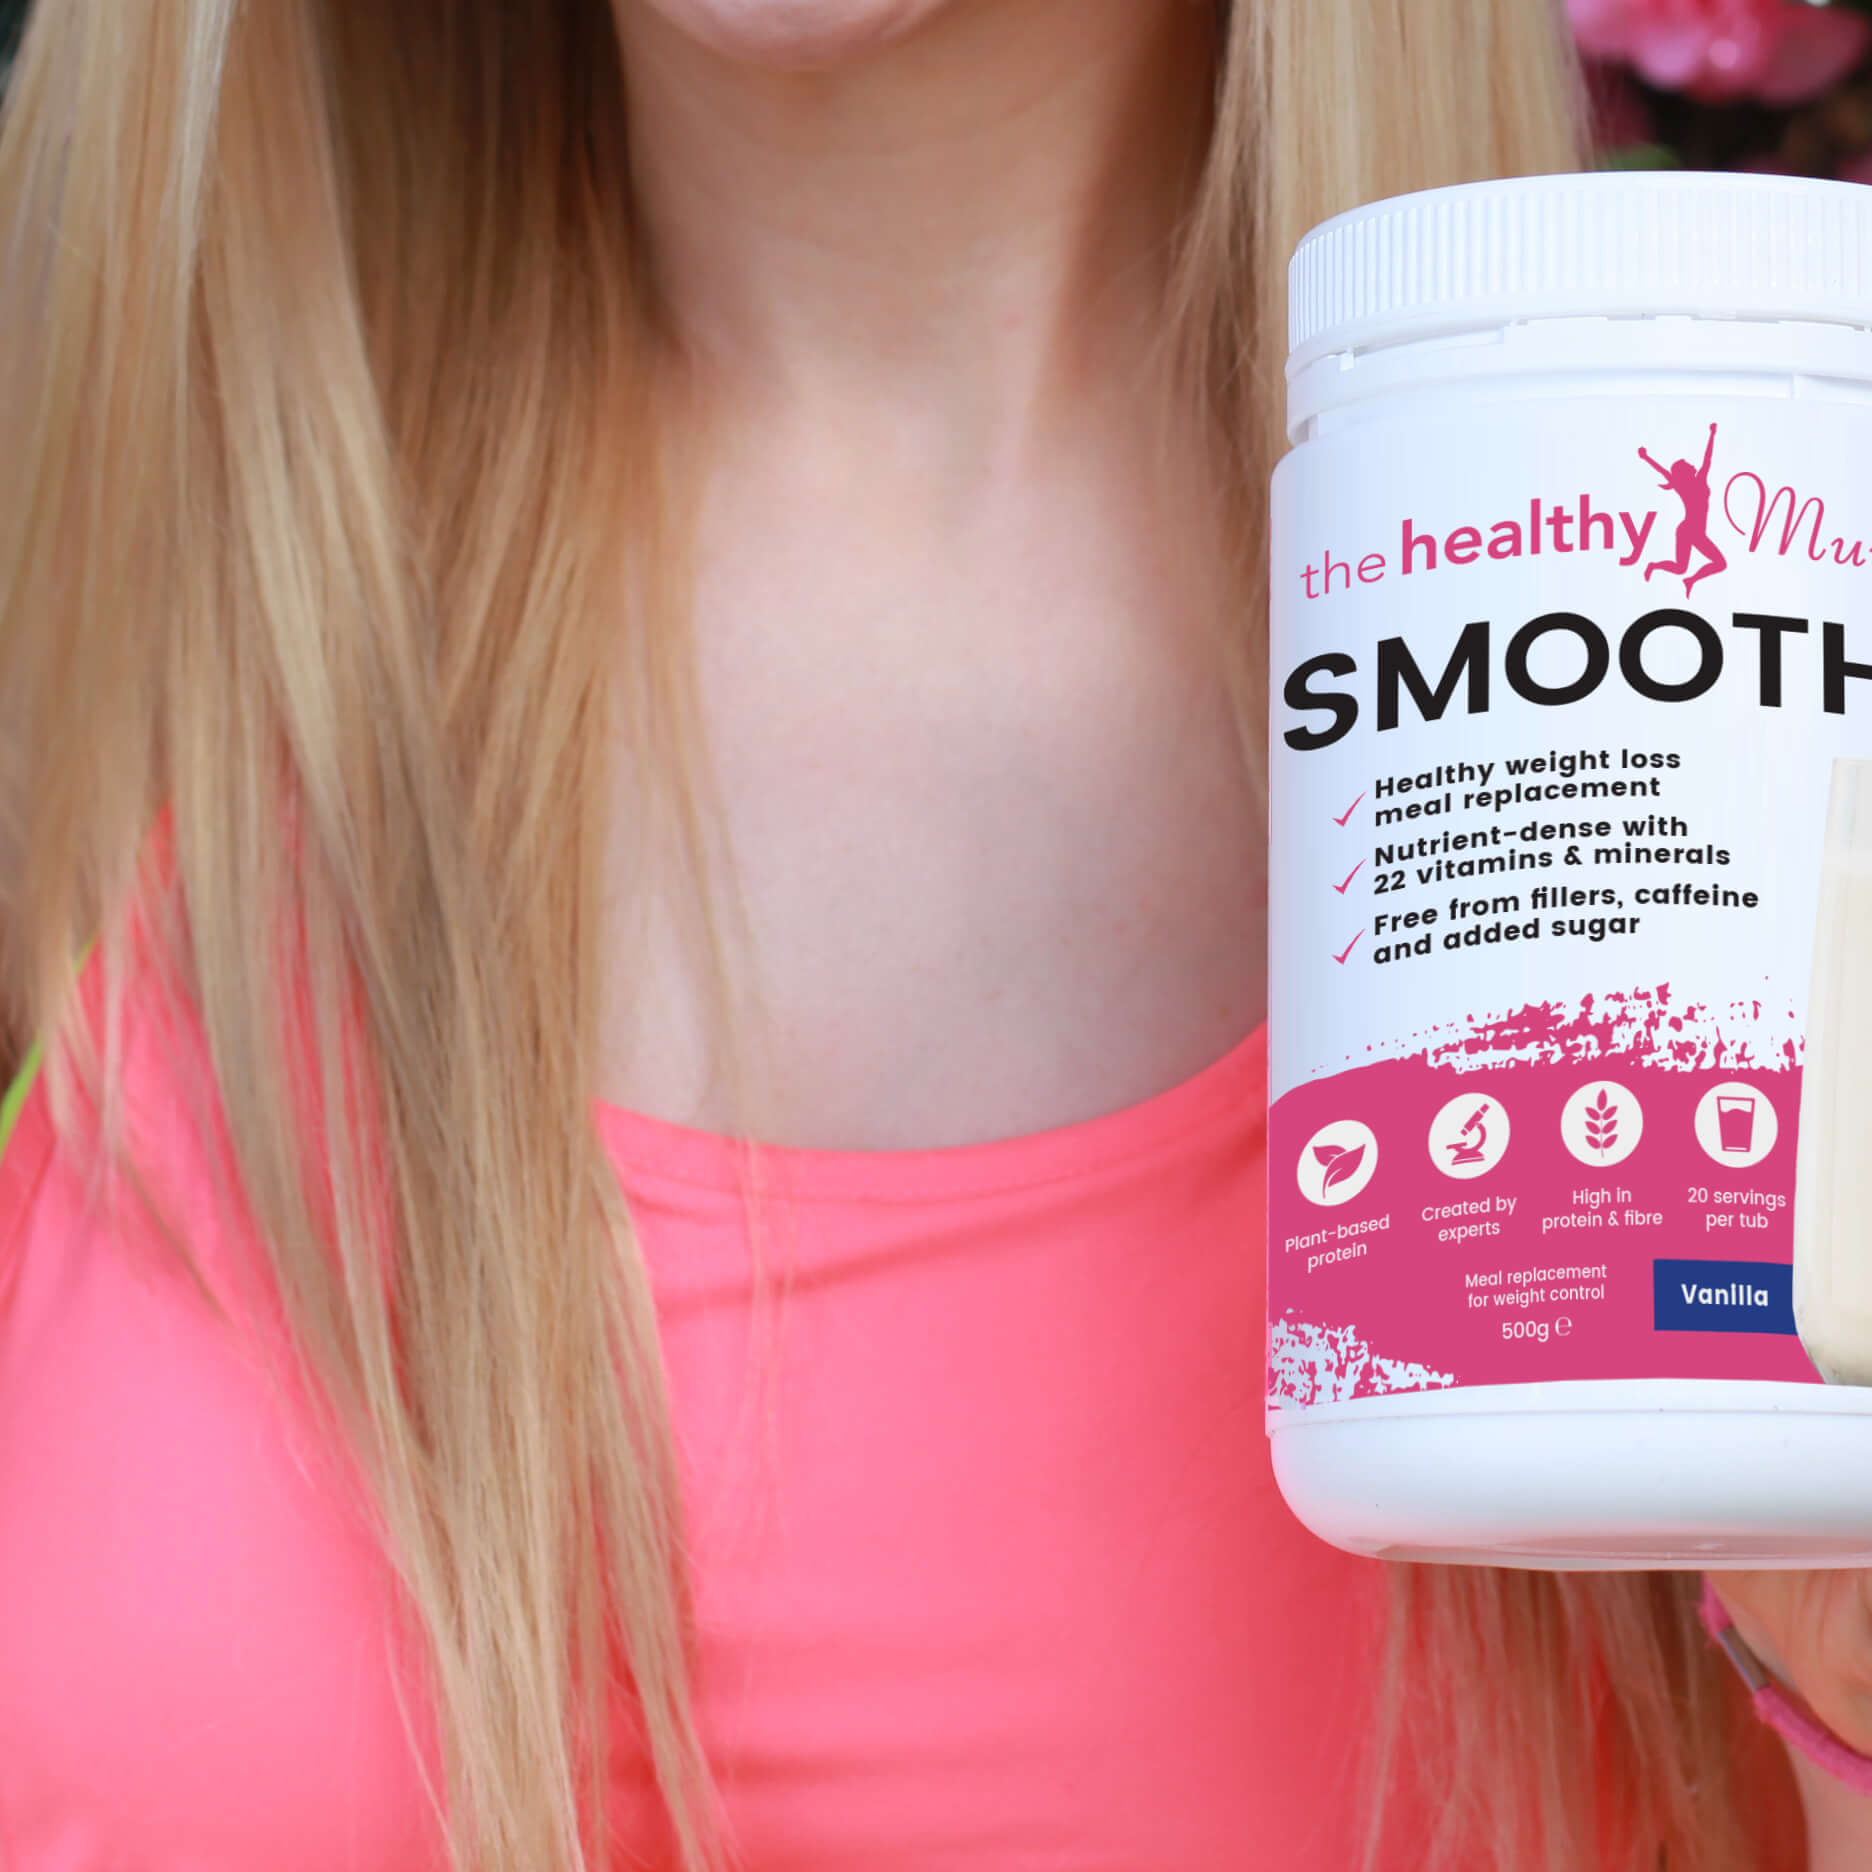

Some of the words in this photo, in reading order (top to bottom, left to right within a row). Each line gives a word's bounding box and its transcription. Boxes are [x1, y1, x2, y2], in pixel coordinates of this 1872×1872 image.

[1299, 549, 1386, 600] the
[1401, 493, 1657, 576] healthy
[1375, 762, 1495, 799] Healthy
[1505, 750, 1610, 778] weight
[1622, 748, 1681, 770] loss
[1375, 792, 1451, 827] meal
[1464, 777, 1660, 813] replacement
[1375, 820, 1611, 867] Nutrient-dense
[1622, 814, 1688, 837] with
[1374, 870, 1406, 895] 22
[1416, 848, 1553, 885] vitamins
[1564, 845, 1583, 866] &
[1594, 841, 1730, 866] minerals
[1374, 908, 1438, 936] Free
[1449, 895, 1520, 921] from
[1531, 886, 1623, 910] fillers,
[1635, 883, 1759, 908] caffeine
[1373, 933, 1431, 964] and
[1443, 917, 1540, 950] added
[1551, 917, 1640, 942] sugar
[1421, 1200, 1491, 1223] Created
[1495, 1195, 1518, 1216] by
[1572, 1187, 1612, 1210] High
[1616, 1186, 1632, 1204] in
[1687, 1186, 1709, 1204] 20
[1713, 1188, 1787, 1212] servings
[1285, 1213, 1390, 1254] Plant-based
[1437, 1220, 1501, 1245] experts
[1542, 1211, 1603, 1235] protein
[1607, 1210, 1620, 1227] &
[1623, 1209, 1664, 1226] fibre
[1705, 1212, 1735, 1233] per
[1739, 1212, 1769, 1229] tub
[1307, 1241, 1368, 1274] protein
[1465, 1269, 1503, 1289] Meal
[1507, 1263, 1608, 1290] replacement
[1468, 1292, 1490, 1309] for
[1492, 1287, 1546, 1309] weight
[1549, 1283, 1605, 1302] control
[1680, 1282, 1769, 1307] Vanilla
[1502, 1320, 1550, 1343] 500g
